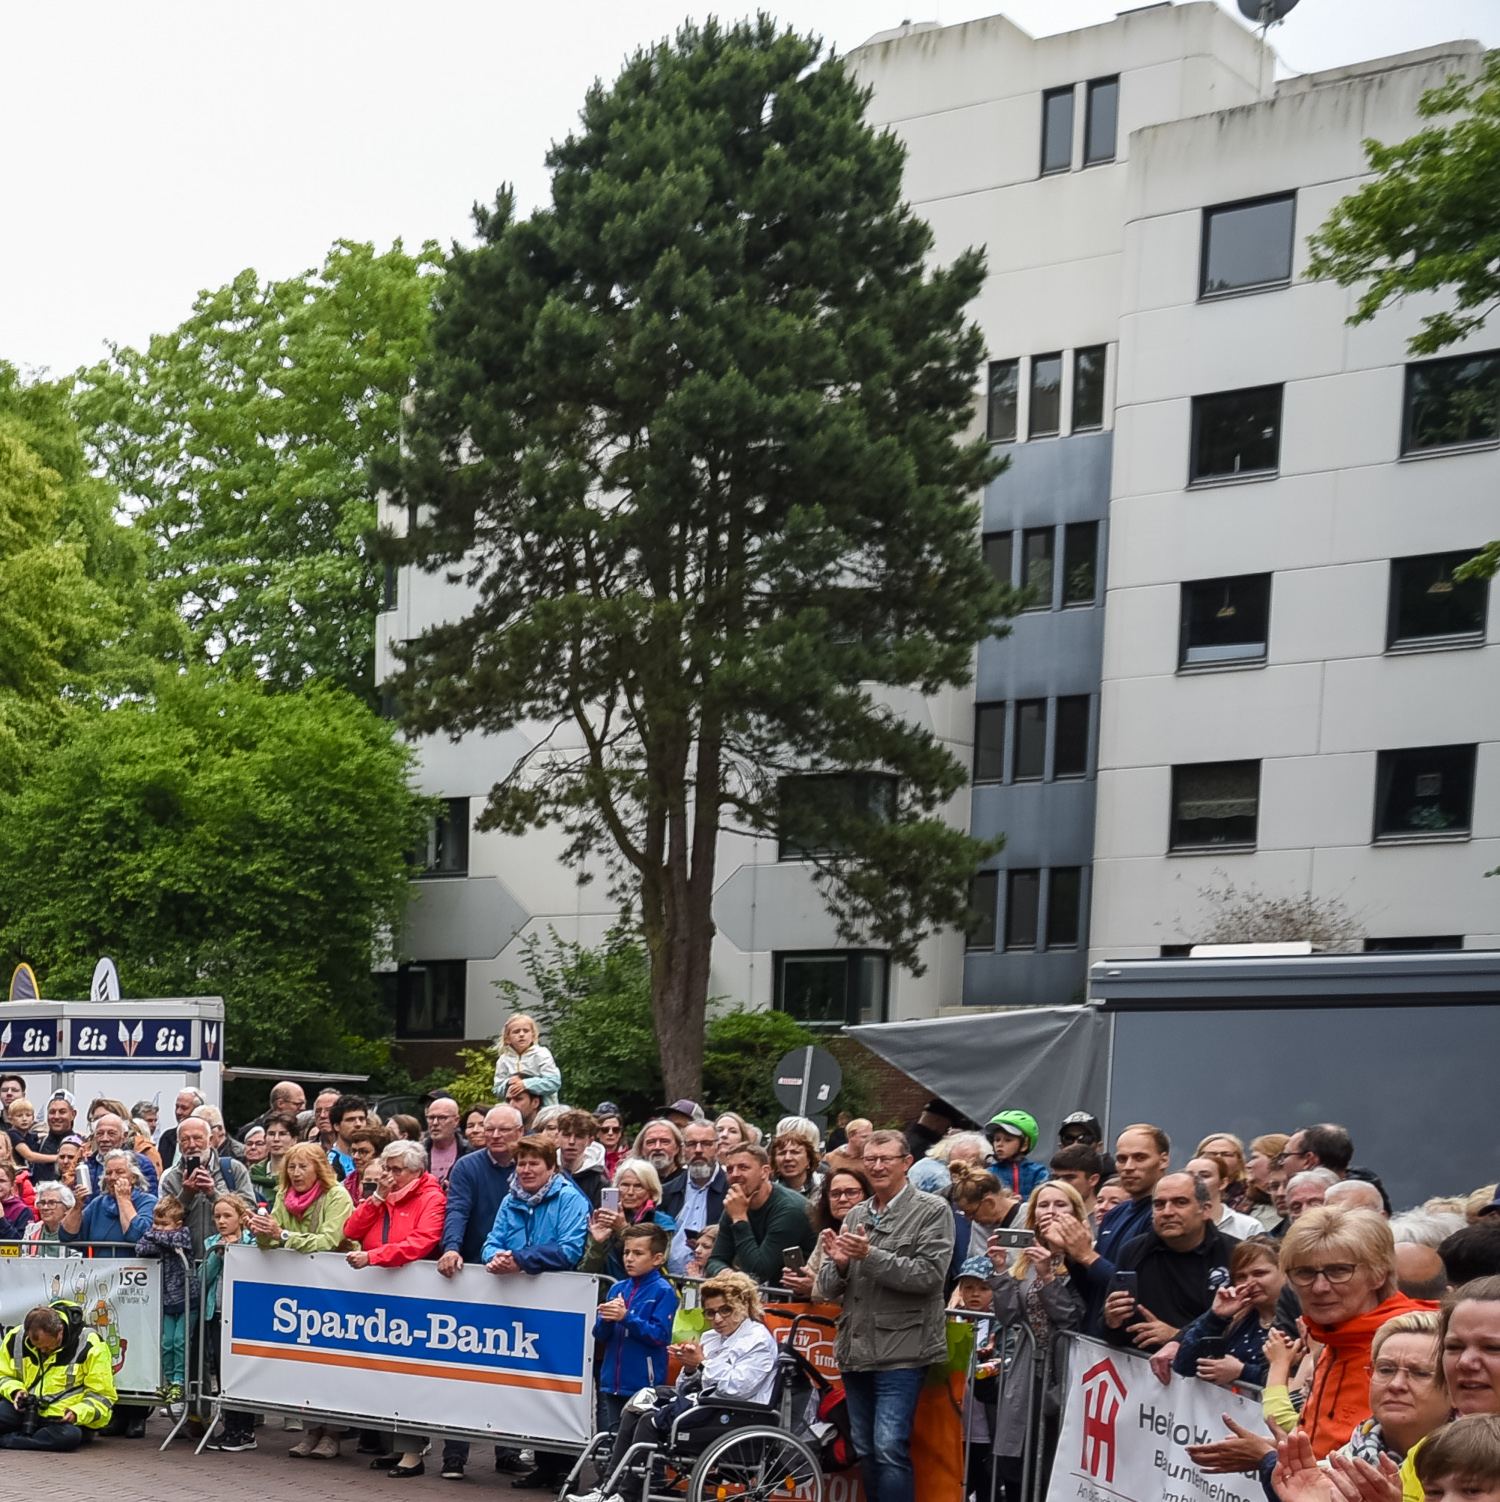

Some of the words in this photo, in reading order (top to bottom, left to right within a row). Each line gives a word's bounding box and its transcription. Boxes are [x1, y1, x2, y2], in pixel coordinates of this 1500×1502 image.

[23, 1027, 49, 1051] Eis
[78, 1027, 107, 1051] Eis
[155, 1028, 184, 1051] Eis
[119, 1267, 147, 1286] ise
[273, 1297, 539, 1359] Sparda-Bank
[815, 1350, 839, 1368] irm
